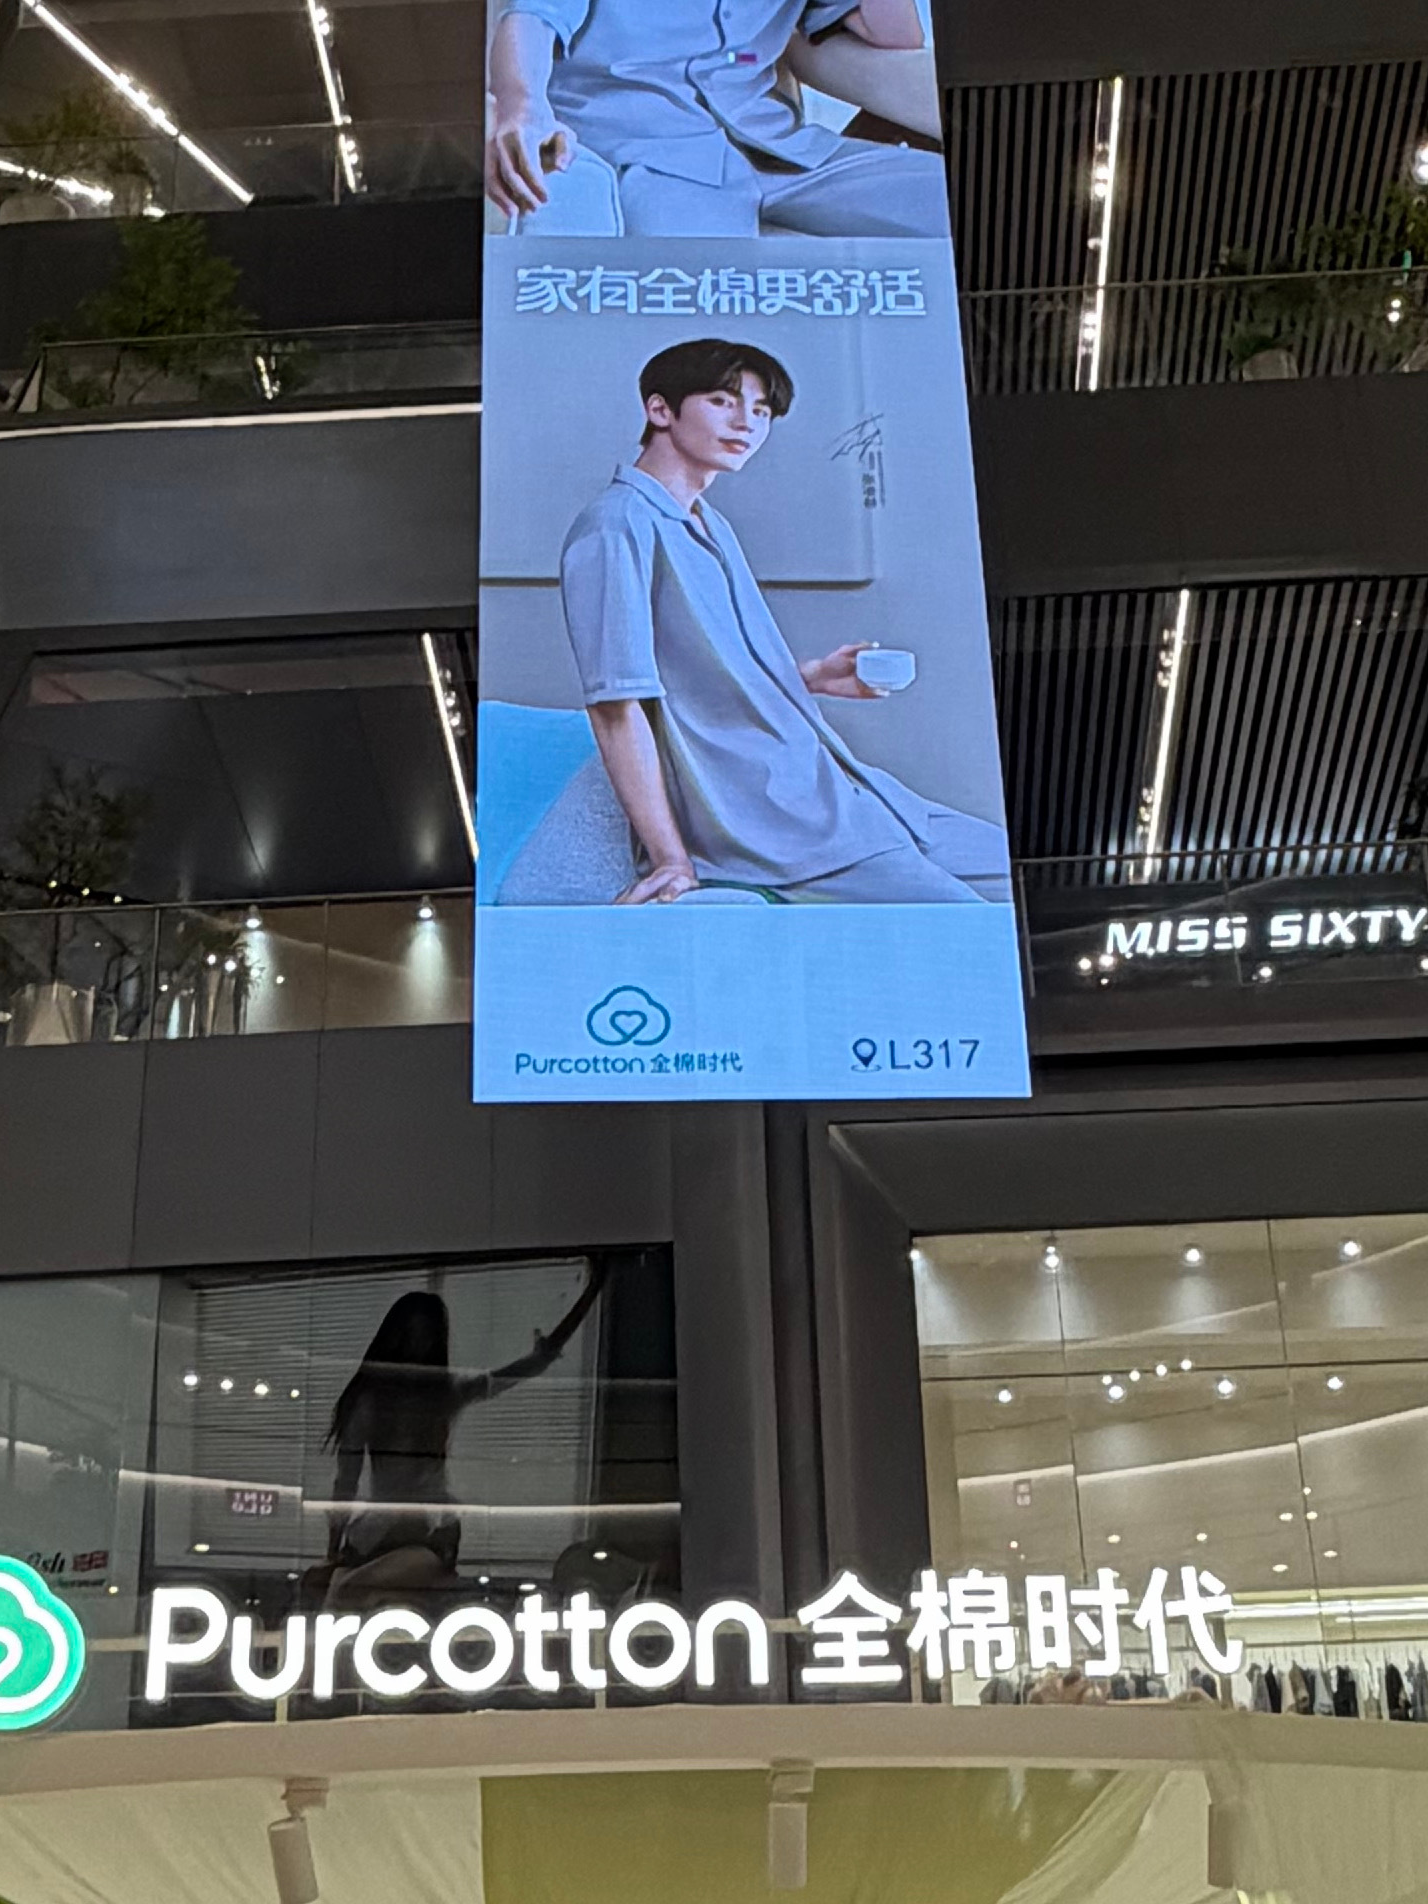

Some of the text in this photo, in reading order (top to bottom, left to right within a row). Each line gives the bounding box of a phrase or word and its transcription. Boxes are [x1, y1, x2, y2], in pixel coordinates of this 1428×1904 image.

[515, 264, 928, 317] 家有全棉更舒适
[1106, 907, 1428, 954] MISS SIXTY
[515, 1052, 744, 1075] Purcotton 全棉时代
[888, 1038, 980, 1070] L317
[145, 1565, 1245, 1701] Purcotton 全棉时代
